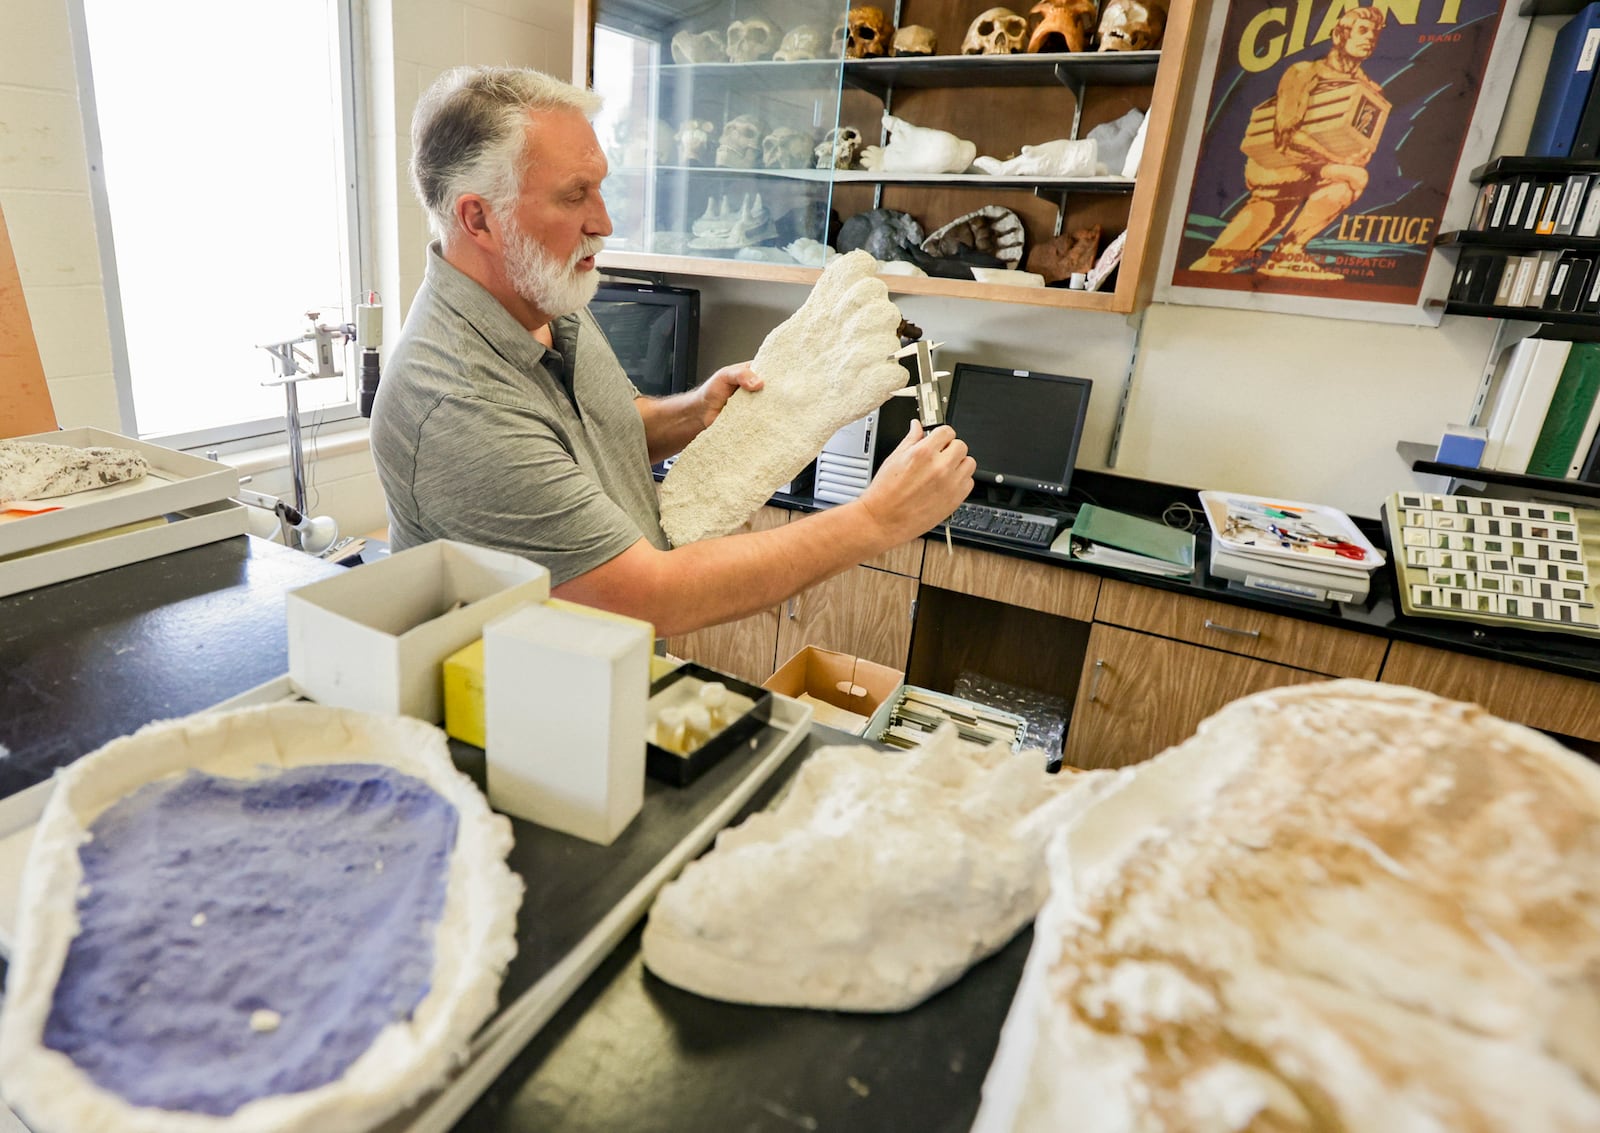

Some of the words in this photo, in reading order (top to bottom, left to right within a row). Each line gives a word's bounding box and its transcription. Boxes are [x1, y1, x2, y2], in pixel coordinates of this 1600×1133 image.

[1418, 32, 1462, 44] BRAND
[1337, 214, 1435, 245] LETTUCE
[1271, 252, 1326, 264] PRODUCE
[1335, 255, 1397, 269] DISPATCH
